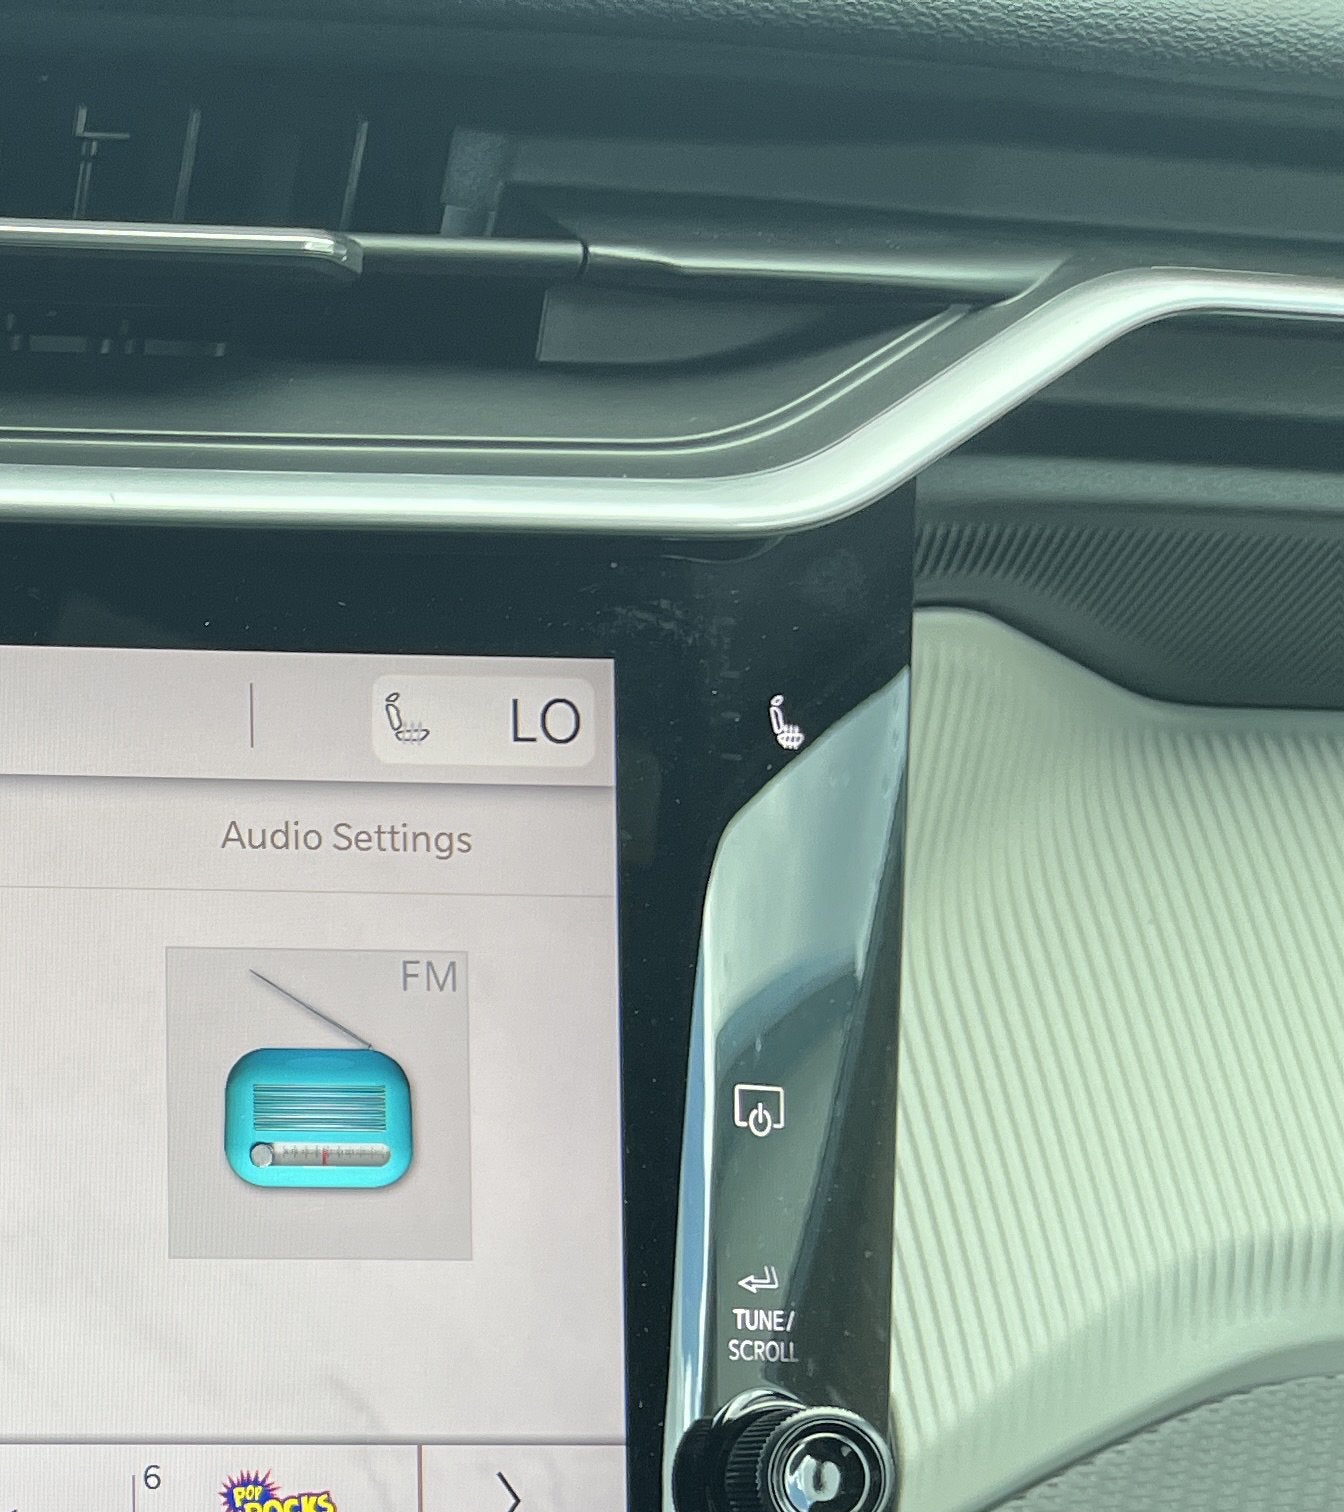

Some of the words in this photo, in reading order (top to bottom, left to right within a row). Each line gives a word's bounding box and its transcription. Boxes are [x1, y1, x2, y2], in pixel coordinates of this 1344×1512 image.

[512, 697, 581, 745] LO
[220, 820, 323, 851] Audio
[332, 822, 473, 861] Settings
[402, 959, 457, 993] FM
[727, 1338, 800, 1364] SCROLL
[143, 1464, 162, 1491] 6
[232, 1483, 263, 1508] POP
